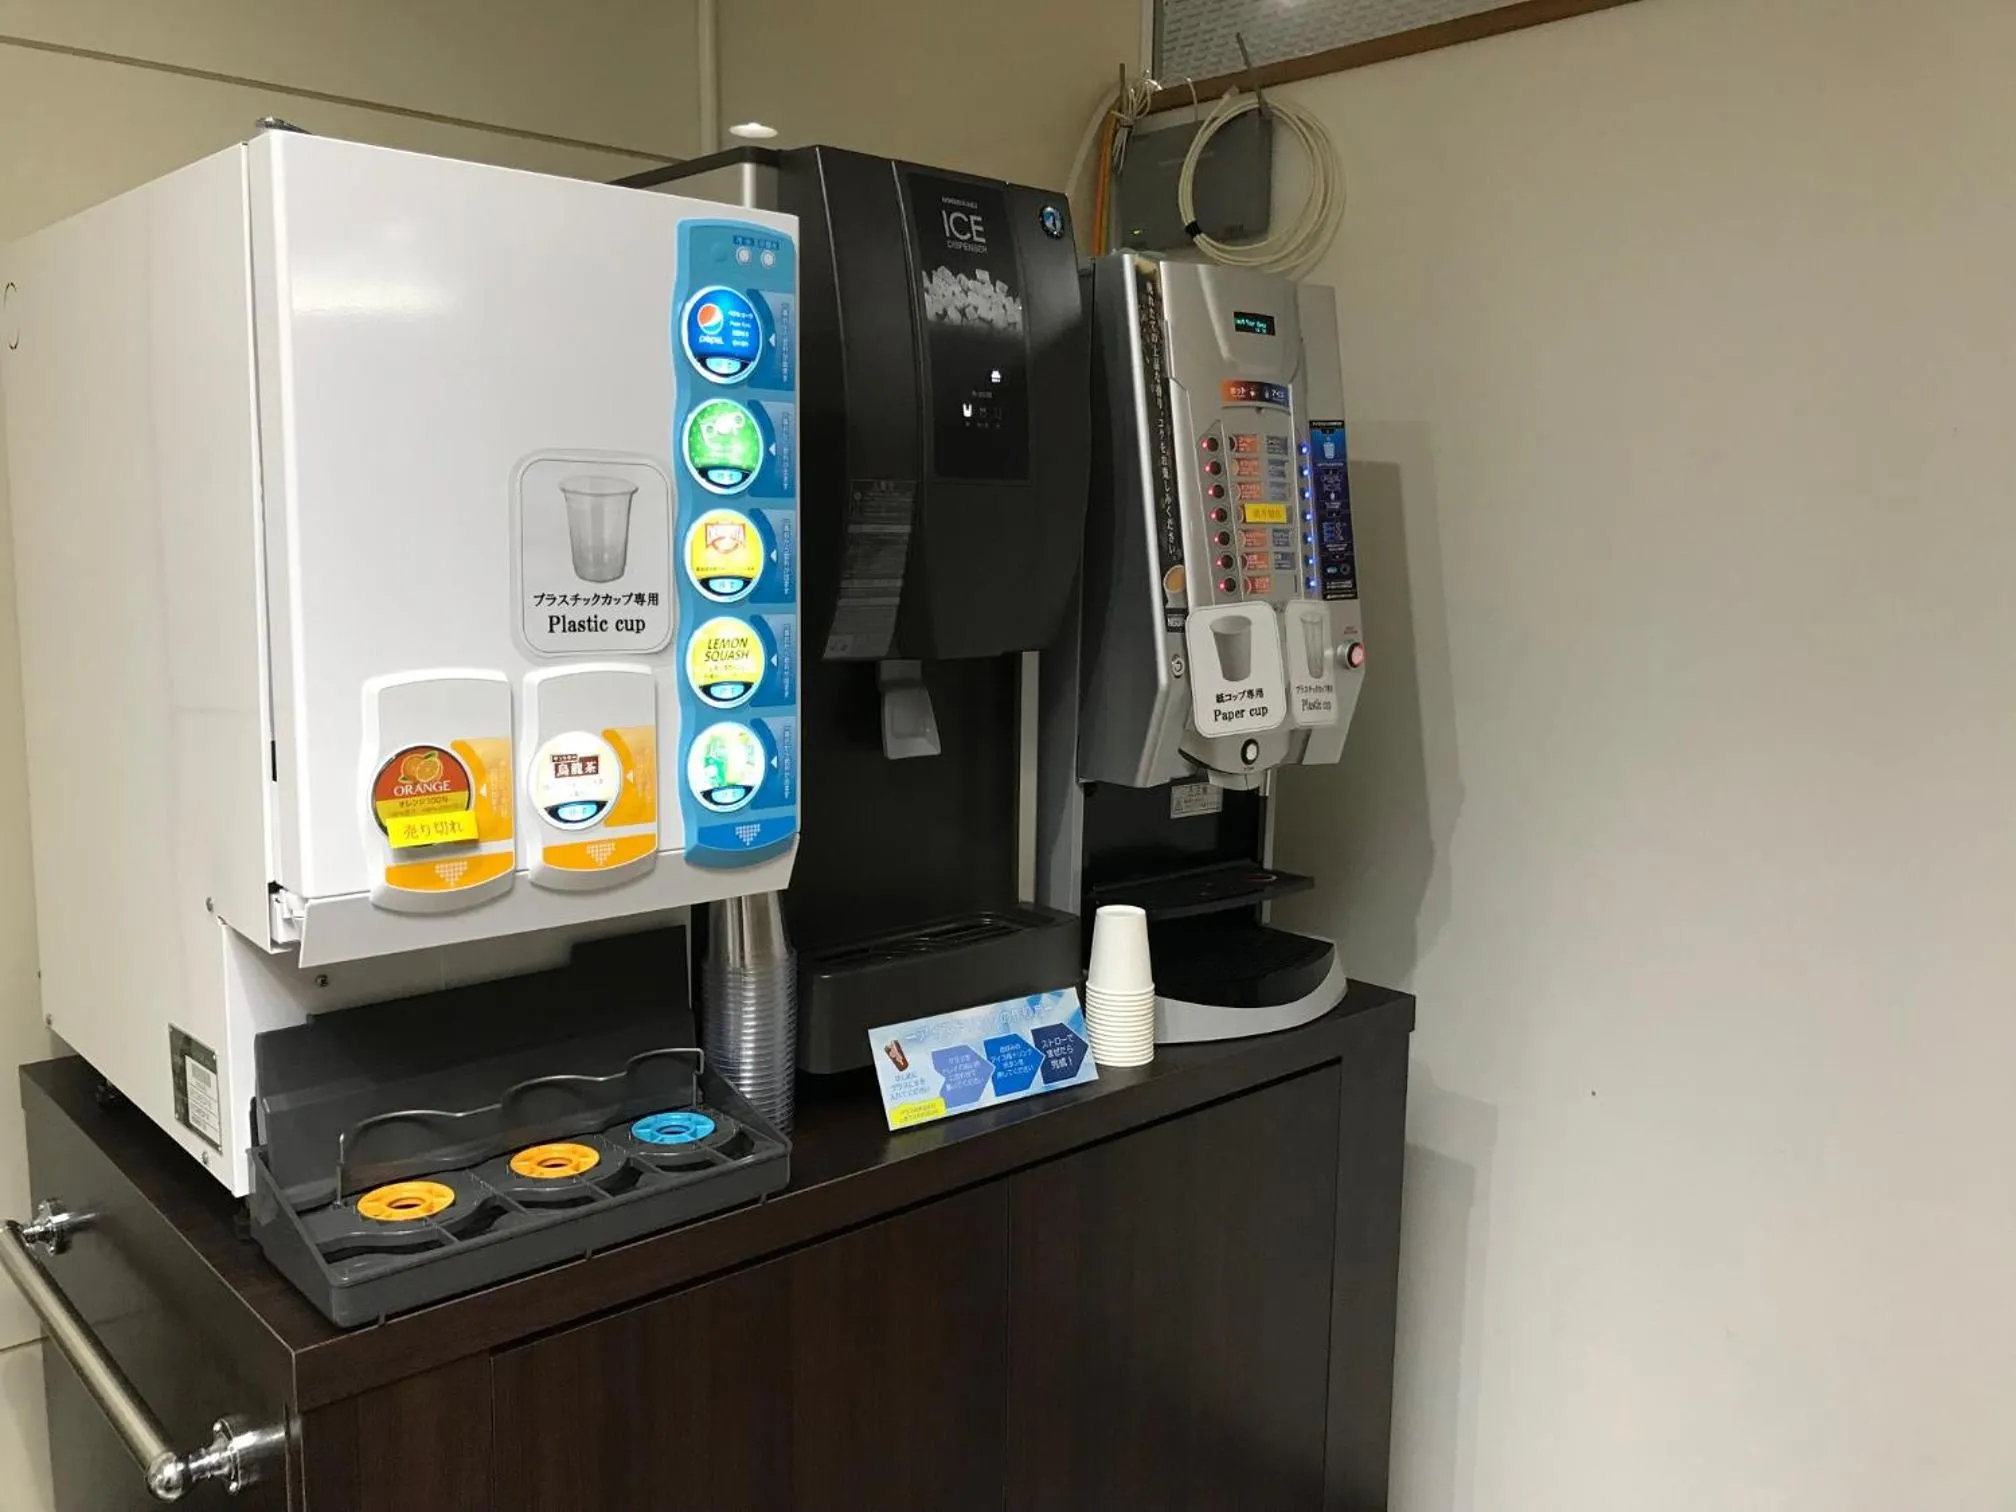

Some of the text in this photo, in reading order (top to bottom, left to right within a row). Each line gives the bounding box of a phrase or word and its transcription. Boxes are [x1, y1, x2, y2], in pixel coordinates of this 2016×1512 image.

[942, 210, 986, 243] ICE
[533, 592, 659, 607] プラスチックカップ専用
[548, 615, 646, 634] Plastic cup
[707, 637, 748, 650] LEMON
[704, 649, 750, 662] SQUASH
[1215, 688, 1264, 704] 紙コップ専用
[1213, 705, 1268, 723] Paper cup
[393, 780, 452, 797] ORANGE
[403, 819, 465, 841] 売り切れ
